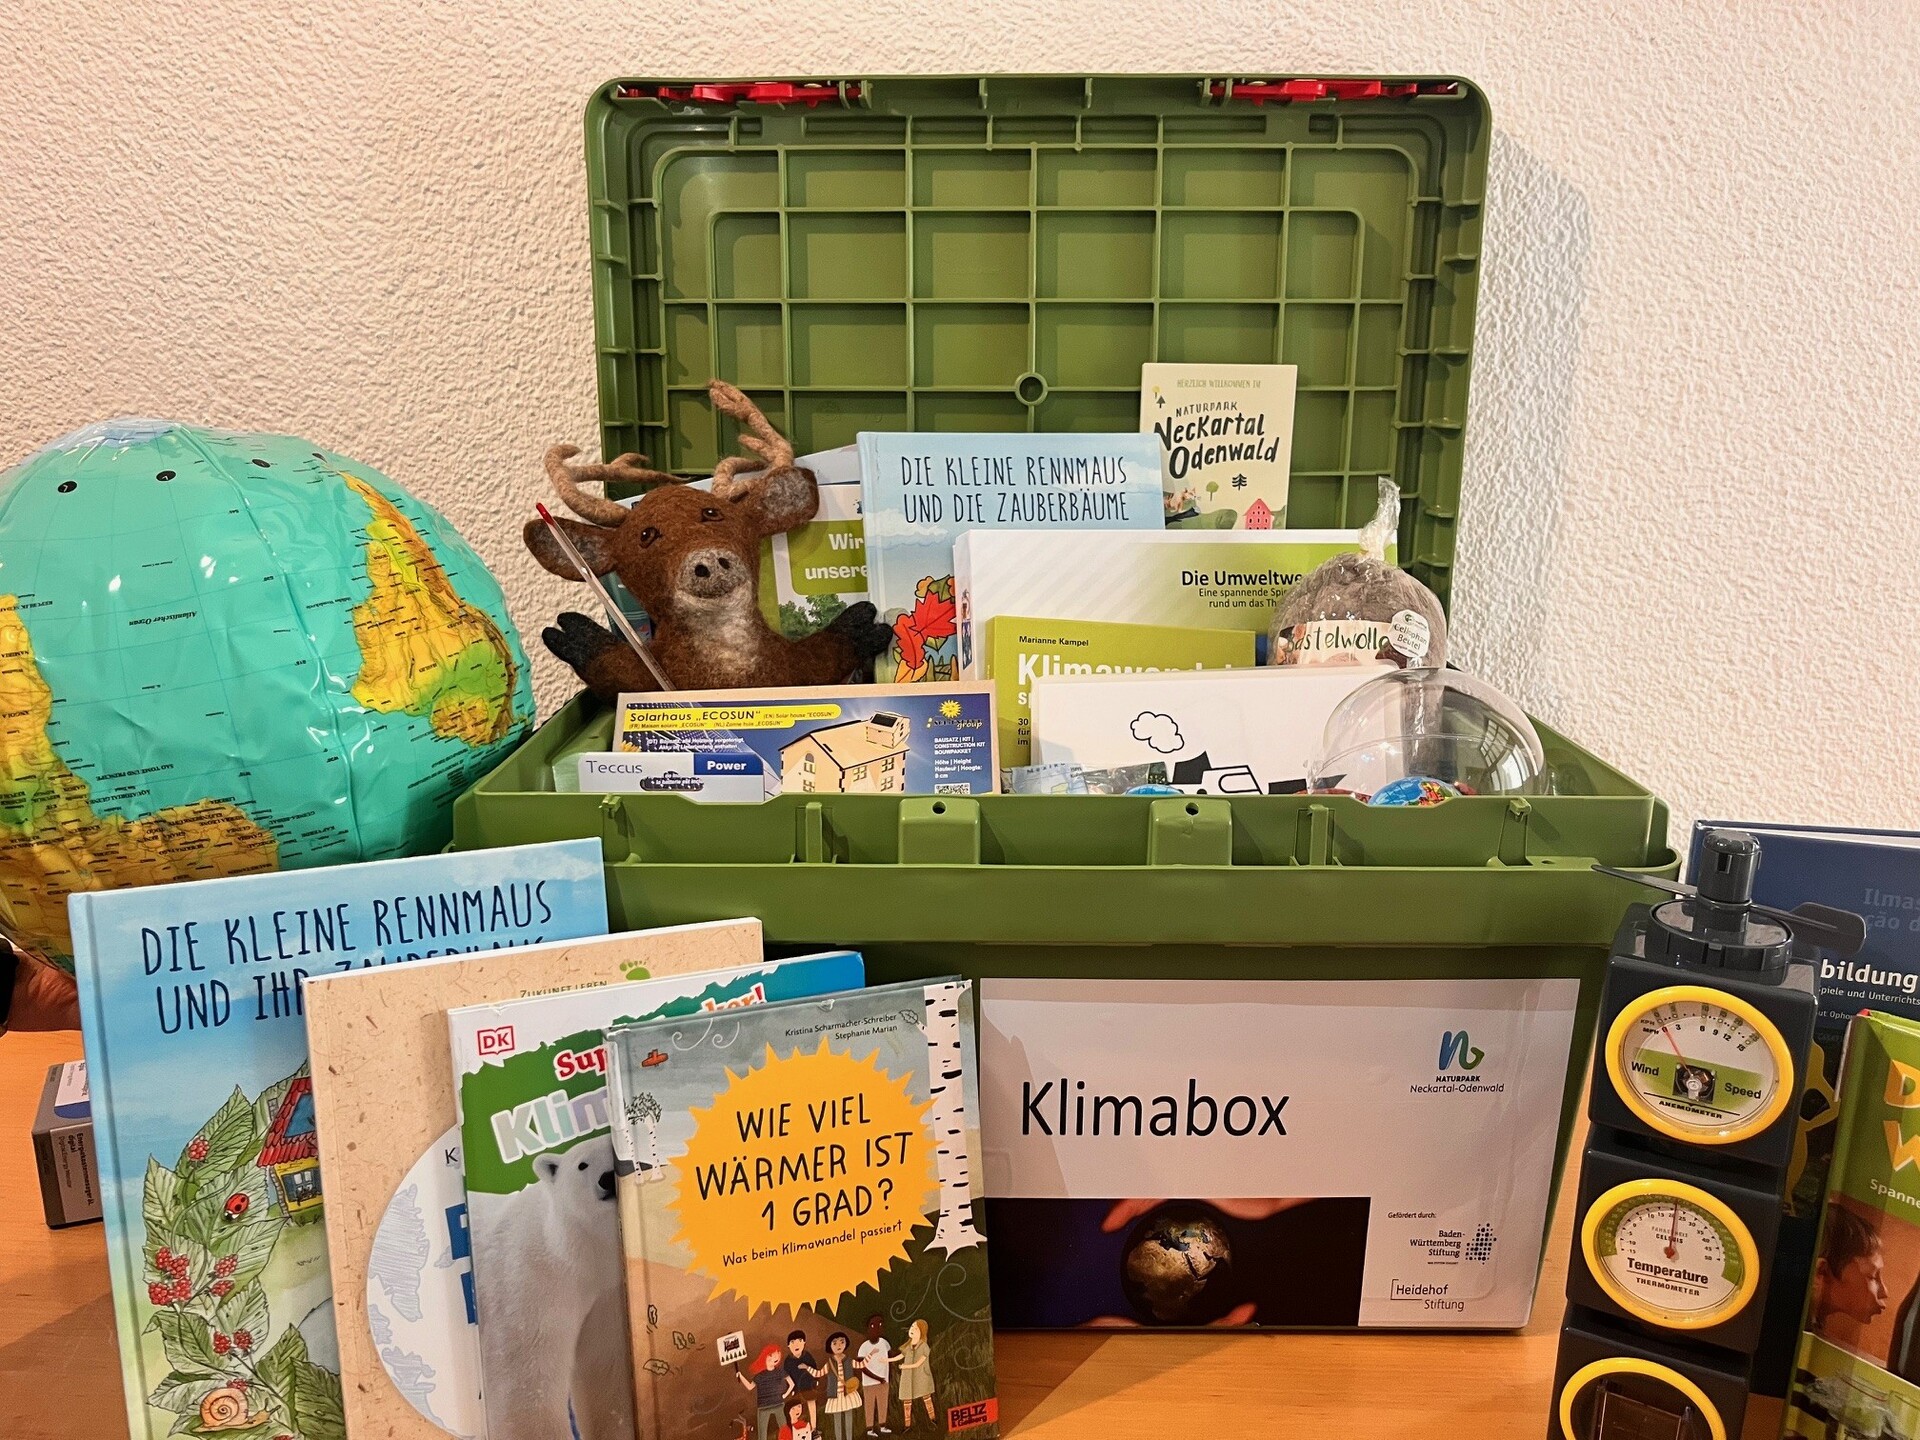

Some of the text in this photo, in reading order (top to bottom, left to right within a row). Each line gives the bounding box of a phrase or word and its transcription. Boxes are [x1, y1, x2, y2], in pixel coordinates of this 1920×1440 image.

[1176, 401, 1238, 417] NATURPARK
[1169, 437, 1280, 479] Odenwald
[901, 455, 1128, 487] DIE KLEINE RENNMAUS
[903, 487, 1130, 524] UND DIE ZAUBERBÄUME
[1181, 570, 1209, 587] Die
[1199, 587, 1217, 598] Eine
[1219, 587, 1265, 599] spannende
[1209, 598, 1230, 609] rund
[1232, 600, 1247, 609] um
[1249, 598, 1264, 608] das
[1019, 636, 1089, 647] Marianne Kampel
[1397, 634, 1421, 650] Beutel
[630, 712, 692, 723] Solarhaus
[1018, 718, 1029, 726] 30
[586, 760, 643, 774] Teccus
[707, 760, 747, 771] Power
[142, 921, 206, 977] DIE
[225, 902, 357, 966] KLEINE
[373, 879, 553, 946] RENNMAUS
[1820, 959, 1919, 994] bildung
[1819, 986, 1844, 996] piele
[1847, 990, 1866, 999] und
[155, 979, 231, 1035] UND
[785, 1013, 897, 1037] Kristina Scharmacher-Schreiber
[835, 1025, 898, 1041] Stephanie Marian
[1675, 1023, 1682, 1031] 3
[1722, 1033, 1732, 1042] 12
[483, 1031, 510, 1051] DK
[1435, 1075, 1481, 1083] NATURPARK
[1631, 1061, 1762, 1099] Wind Speed
[1410, 1083, 1505, 1093] Neckartal-Odenwald
[1021, 1078, 1290, 1137] Klimabox
[1658, 1101, 1723, 1119] ANEMOMETER
[736, 1092, 871, 1142] WIE VIEL
[696, 1132, 914, 1201] WÄRMER IST
[761, 1178, 894, 1231] 1 GRAD?
[1438, 1230, 1466, 1238] Baden-
[722, 1219, 903, 1267] Was beim Klimawandel passiert
[1409, 1239, 1462, 1249] Württemberg
[1428, 1248, 1461, 1259] Stiftung
[1627, 1257, 1709, 1284] Temperature
[1396, 1284, 1449, 1295] Heidehof
[1636, 1277, 1700, 1297] THERMOMETER
[1424, 1299, 1465, 1312] Stiftung
[951, 1403, 987, 1421] BELTZ
